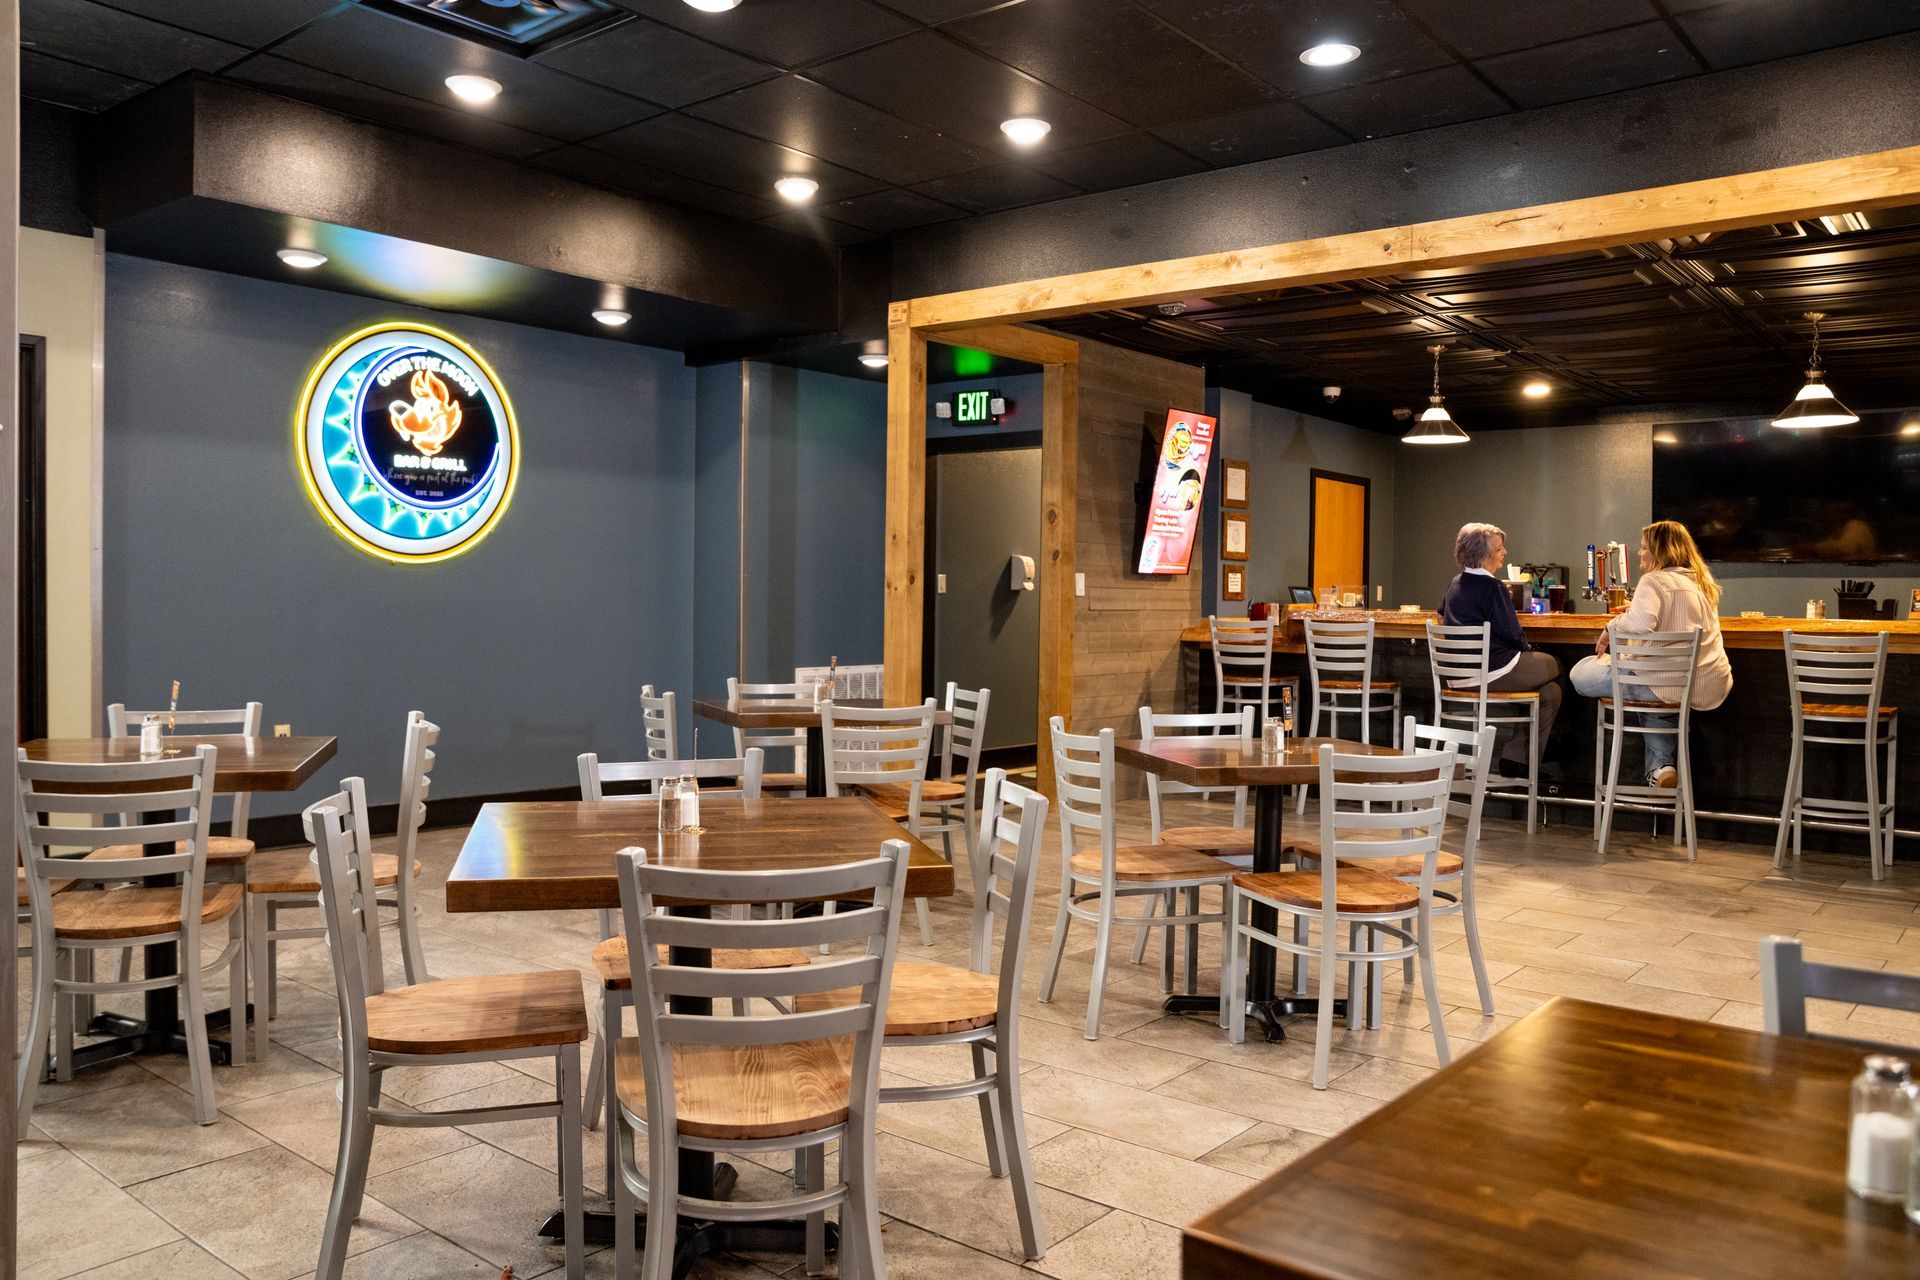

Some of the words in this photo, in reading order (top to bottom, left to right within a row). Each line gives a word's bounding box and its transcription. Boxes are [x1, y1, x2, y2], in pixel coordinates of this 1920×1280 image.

[377, 358, 414, 387] OVER
[410, 355, 442, 372] THE
[441, 360, 480, 397] MOON
[958, 391, 989, 421] EXIT
[393, 454, 420, 469] BAR
[431, 457, 468, 471] GRILL
